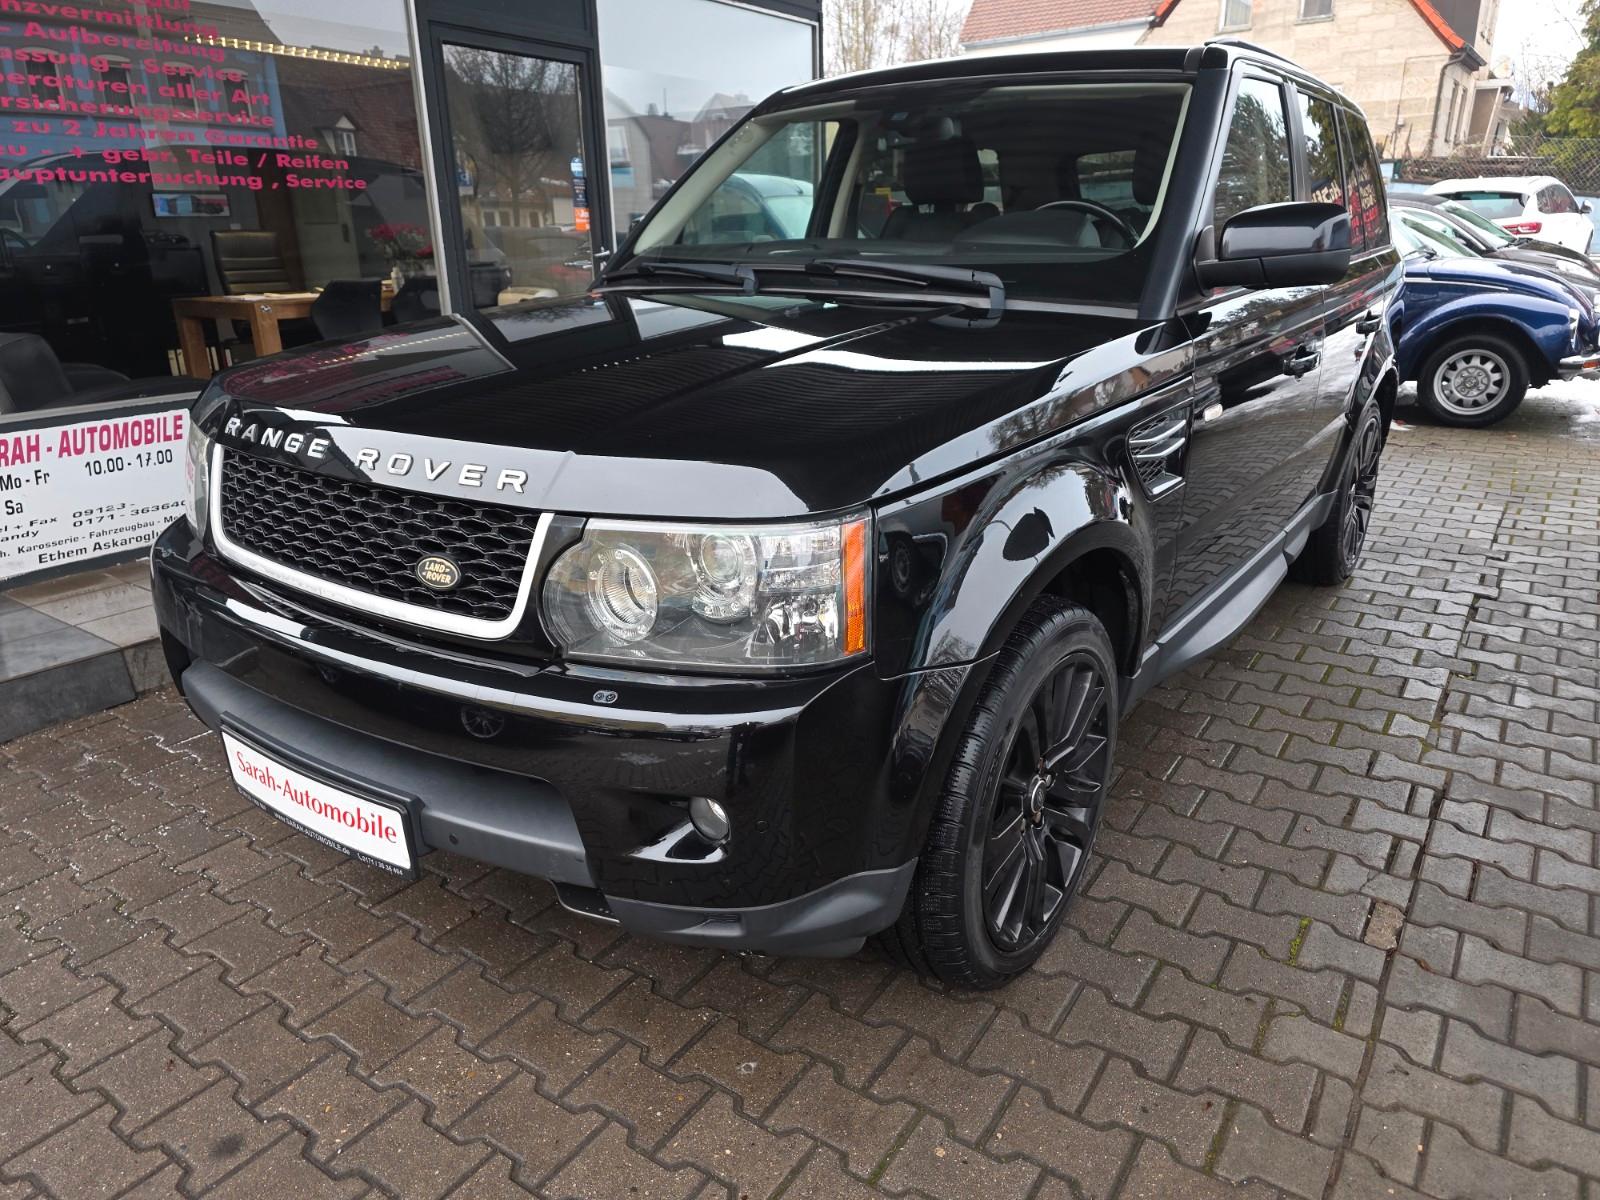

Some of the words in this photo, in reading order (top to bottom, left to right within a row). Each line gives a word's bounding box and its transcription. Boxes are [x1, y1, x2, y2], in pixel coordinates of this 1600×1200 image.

[23, 21, 225, 62] Aufbereitung
[143, 58, 243, 82] Service
[0, 72, 147, 95] eraturen
[158, 82, 222, 101] aller
[231, 88, 270, 106] Art
[0, 93, 275, 127] rsicherungsservice
[12, 120, 51, 135] zu
[62, 118, 82, 137] 2
[93, 120, 196, 143] Jahren
[204, 127, 319, 150] Garantie
[101, 145, 178, 165] gebr.
[188, 149, 250, 167] Teile
[276, 153, 350, 171] Reifen
[285, 173, 369, 191] Service
[58, 414, 184, 459] AUTOMOBILE
[0, 474, 22, 492] Mo
[34, 468, 50, 486] Fr
[84, 456, 125, 477] 10.00
[135, 448, 174, 469] 17.00
[224, 416, 331, 459] RANGE
[353, 446, 530, 494] ROVER
[4, 499, 24, 516] Sa
[29, 517, 57, 528] Fax
[72, 502, 127, 519] 09123
[72, 513, 116, 528] 0171
[17, 535, 80, 554] Karosserie
[89, 520, 156, 540] Fahrzeugbau
[38, 547, 88, 564] Ethem
[235, 750, 398, 844] Sarah-Automobile
